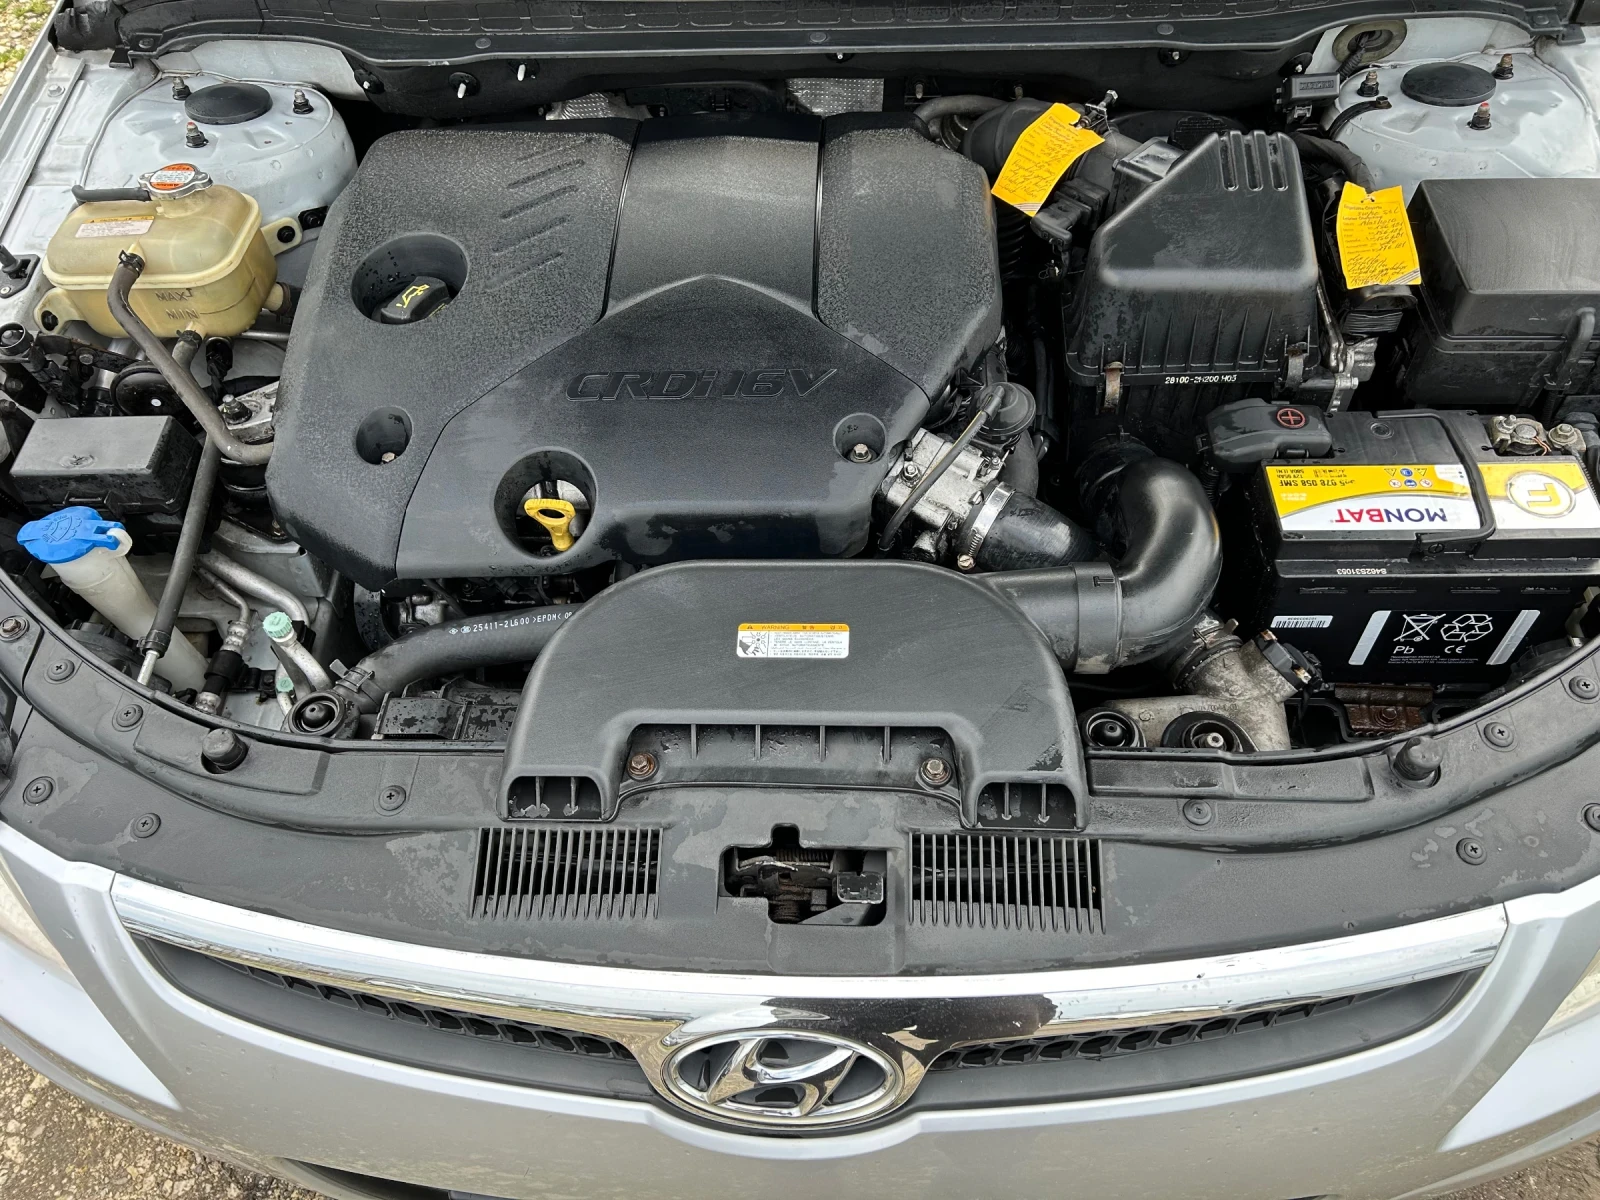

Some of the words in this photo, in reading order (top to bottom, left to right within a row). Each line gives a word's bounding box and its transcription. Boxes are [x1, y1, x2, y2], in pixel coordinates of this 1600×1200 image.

[155, 291, 188, 302] MAX
[166, 308, 199, 320] MIN
[1279, 479, 1299, 487] SMF
[1526, 482, 1561, 509] F
[1335, 508, 1448, 523] MONBAT
[472, 617, 531, 633] 25411-2L600
[1393, 645, 1415, 654] Pb
[1444, 645, 1467, 654] CE
